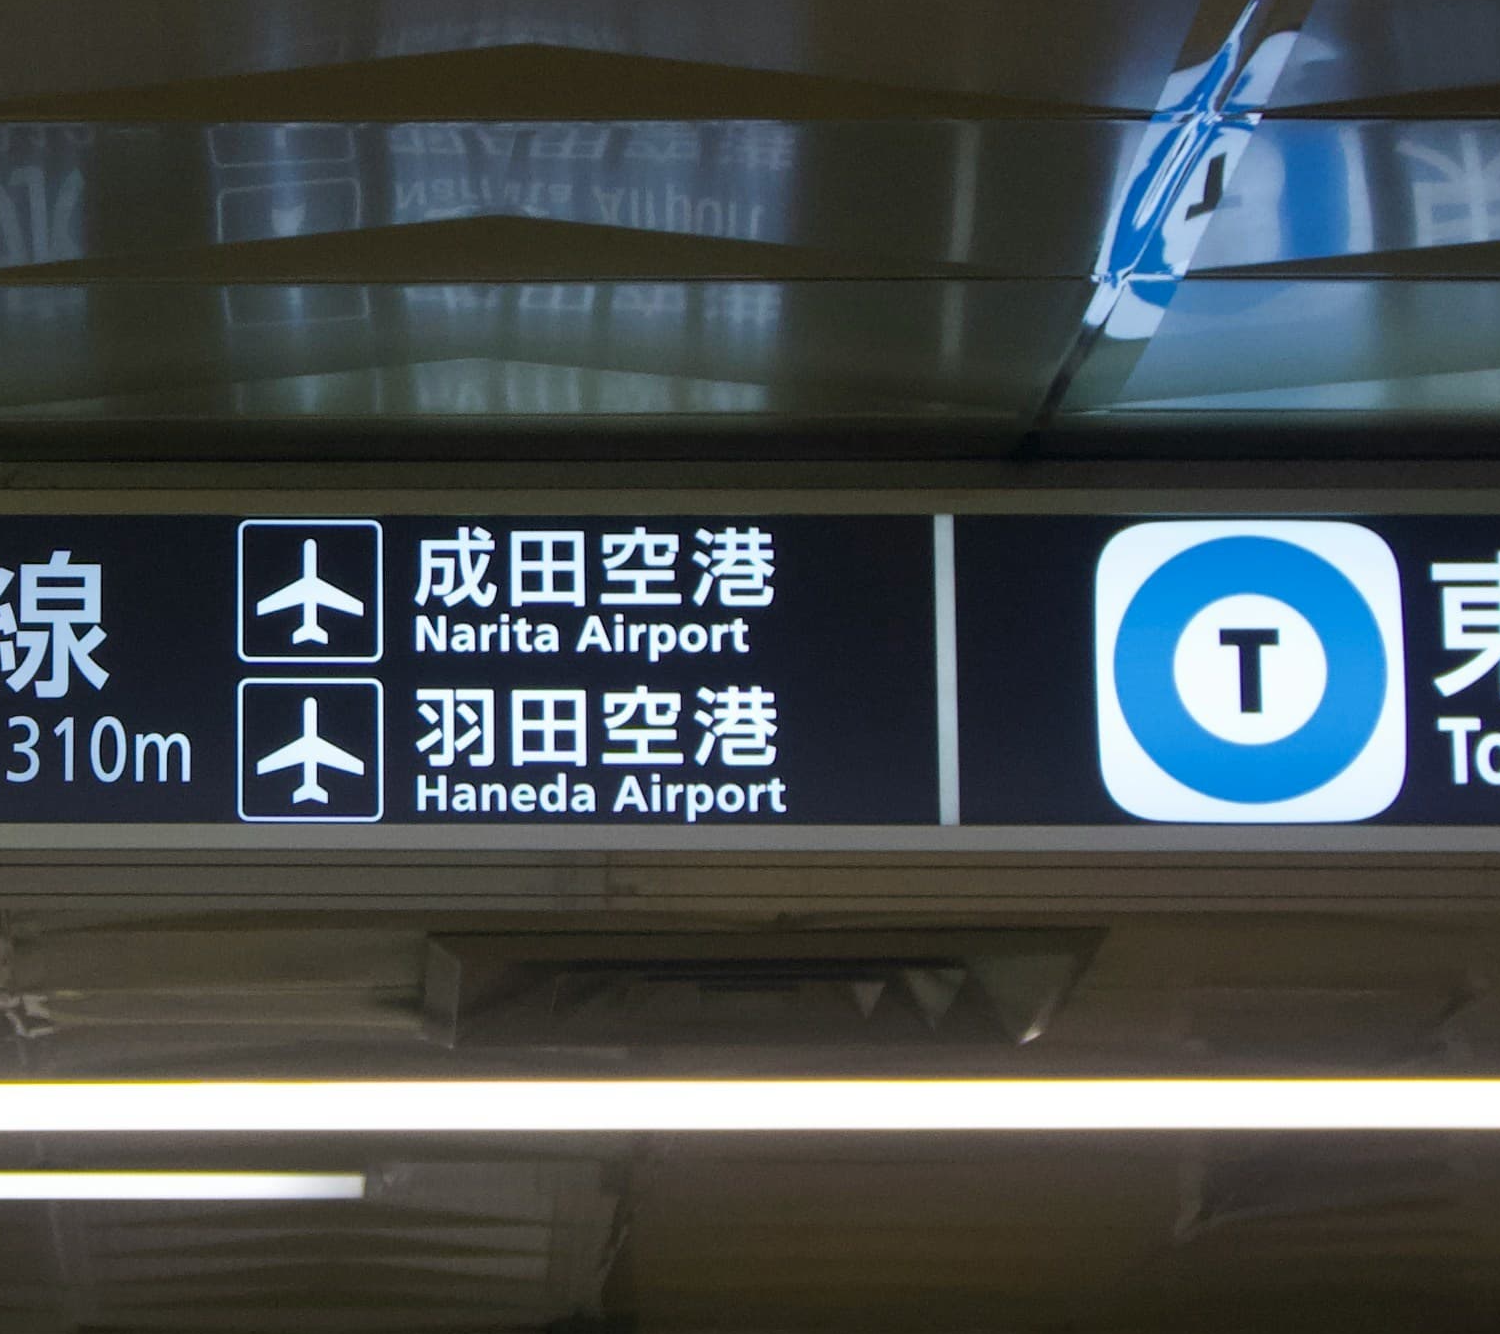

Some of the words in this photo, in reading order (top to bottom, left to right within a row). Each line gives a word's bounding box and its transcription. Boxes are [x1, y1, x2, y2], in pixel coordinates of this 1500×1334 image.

[415, 527, 774, 607] 成田空港
[416, 613, 559, 652] Narita
[576, 613, 749, 662] Airport
[1220, 629, 1278, 712] T
[7, 716, 190, 782] 310m
[416, 685, 777, 766] 羽田空港
[418, 773, 595, 812] Haneda
[613, 773, 786, 822] Airport
